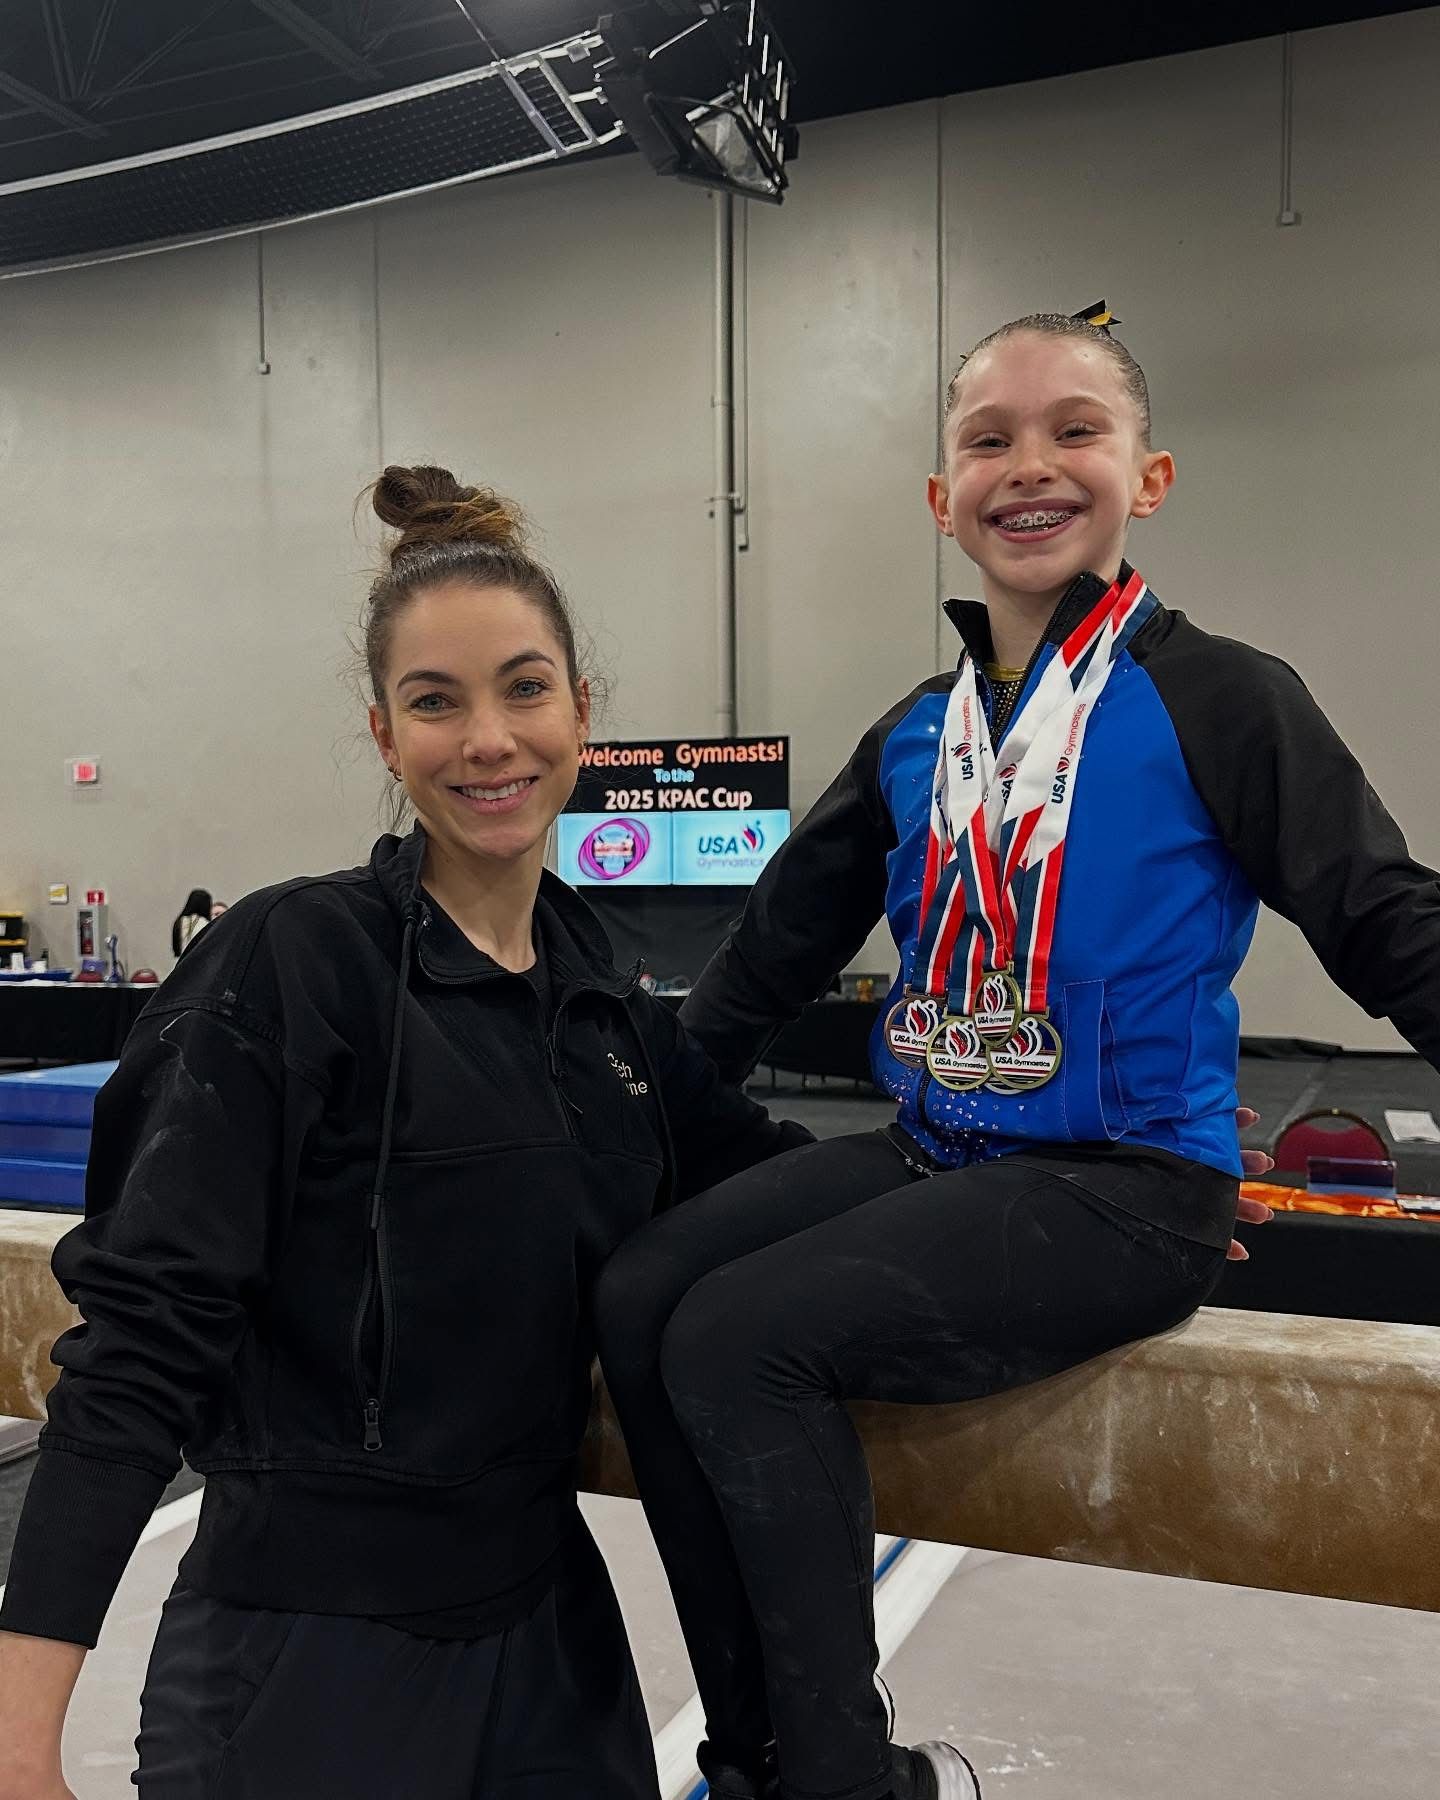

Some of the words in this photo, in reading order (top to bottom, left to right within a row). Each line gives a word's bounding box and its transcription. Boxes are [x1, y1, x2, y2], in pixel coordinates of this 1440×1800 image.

[578, 746, 664, 767] Welcome
[676, 740, 784, 769] Gymnasts!
[653, 768, 669, 783] To
[670, 767, 695, 783] the
[962, 755, 974, 780] USA
[1052, 774, 1067, 803] USA
[605, 789, 654, 810] 2025
[658, 788, 709, 809] KPAC
[712, 787, 753, 811] Cup
[698, 837, 739, 854] USA
[977, 1015, 989, 1024] USA
[894, 1034, 910, 1044] USA
[935, 1057, 951, 1066] USA
[995, 1056, 1013, 1065] USA
